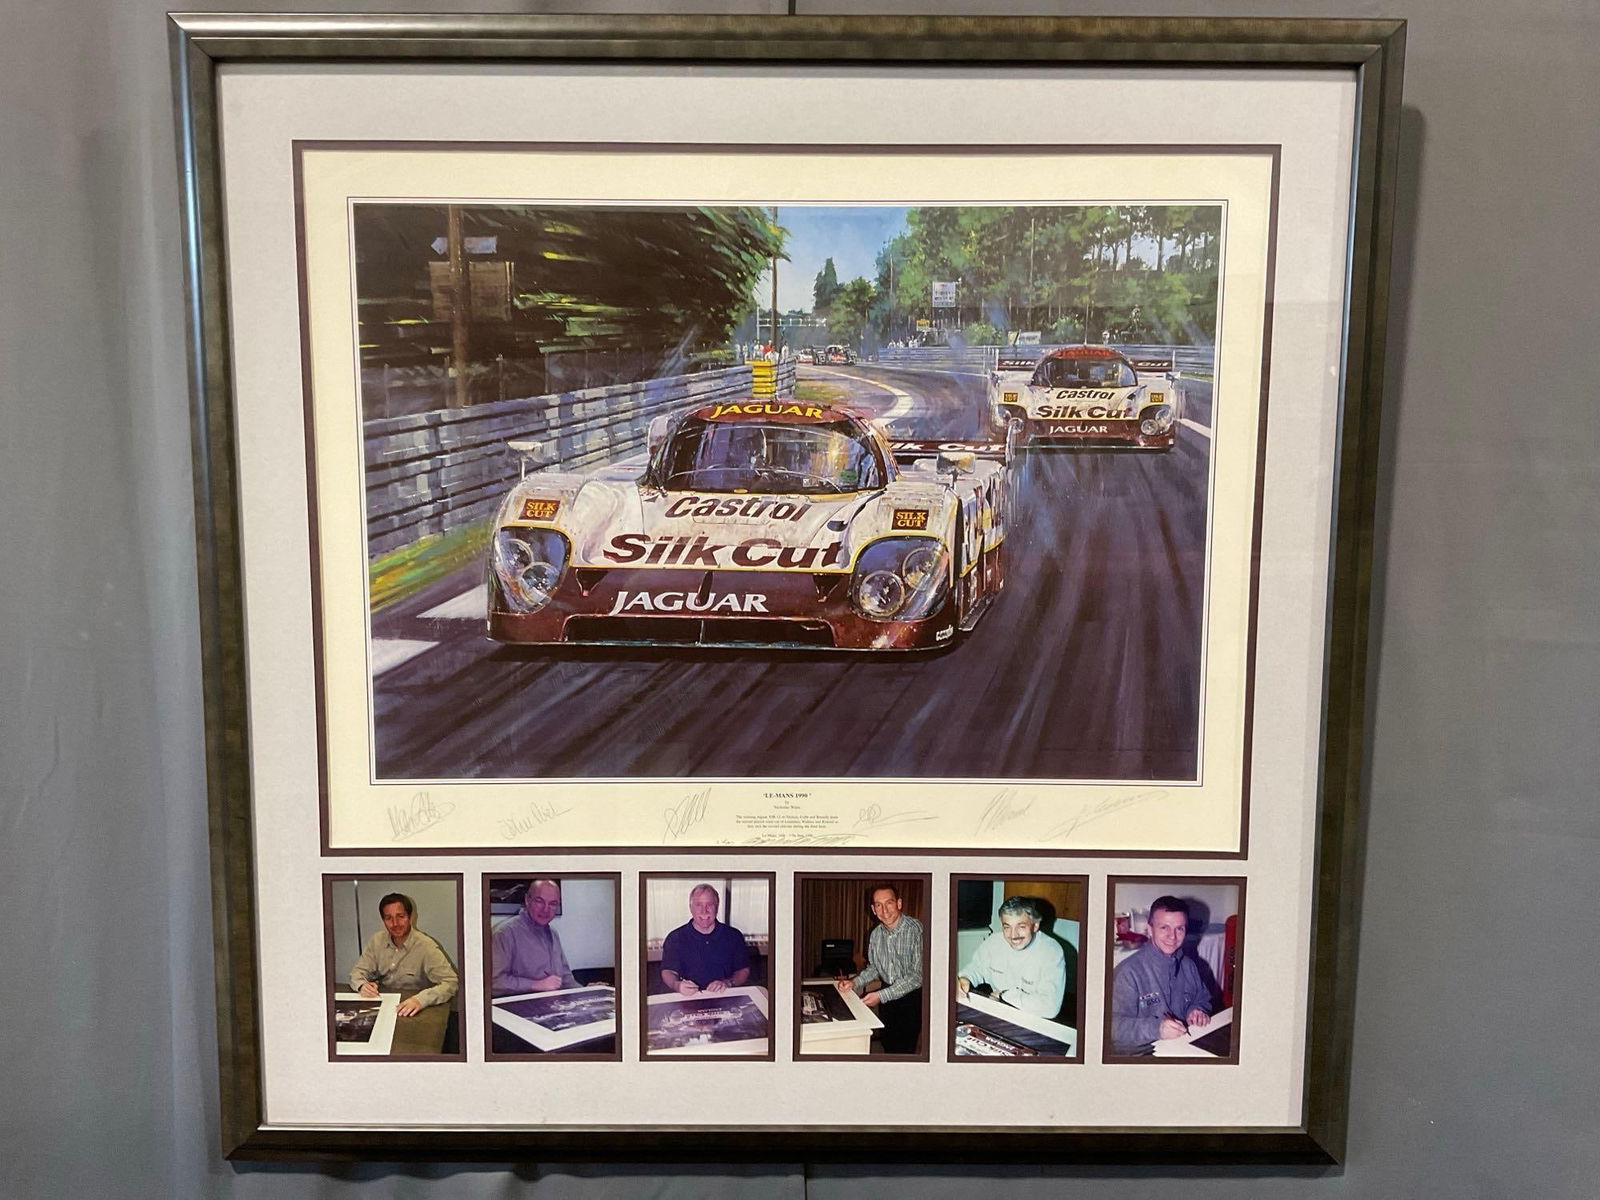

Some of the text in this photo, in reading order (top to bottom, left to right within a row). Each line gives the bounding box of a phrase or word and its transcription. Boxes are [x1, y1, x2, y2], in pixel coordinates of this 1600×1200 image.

[1056, 388, 1115, 400] Castrol
[710, 404, 823, 419] JAGUAR
[1036, 404, 1083, 419] Silk
[1050, 425, 1108, 434] JAGUAR
[526, 502, 557, 511] SILK
[665, 496, 812, 522] Castrol
[526, 510, 553, 518] CUT
[896, 511, 927, 520] SILK
[897, 519, 924, 527] CUT
[603, 533, 843, 568] Silk Cut
[608, 591, 769, 616] JAGUAR
